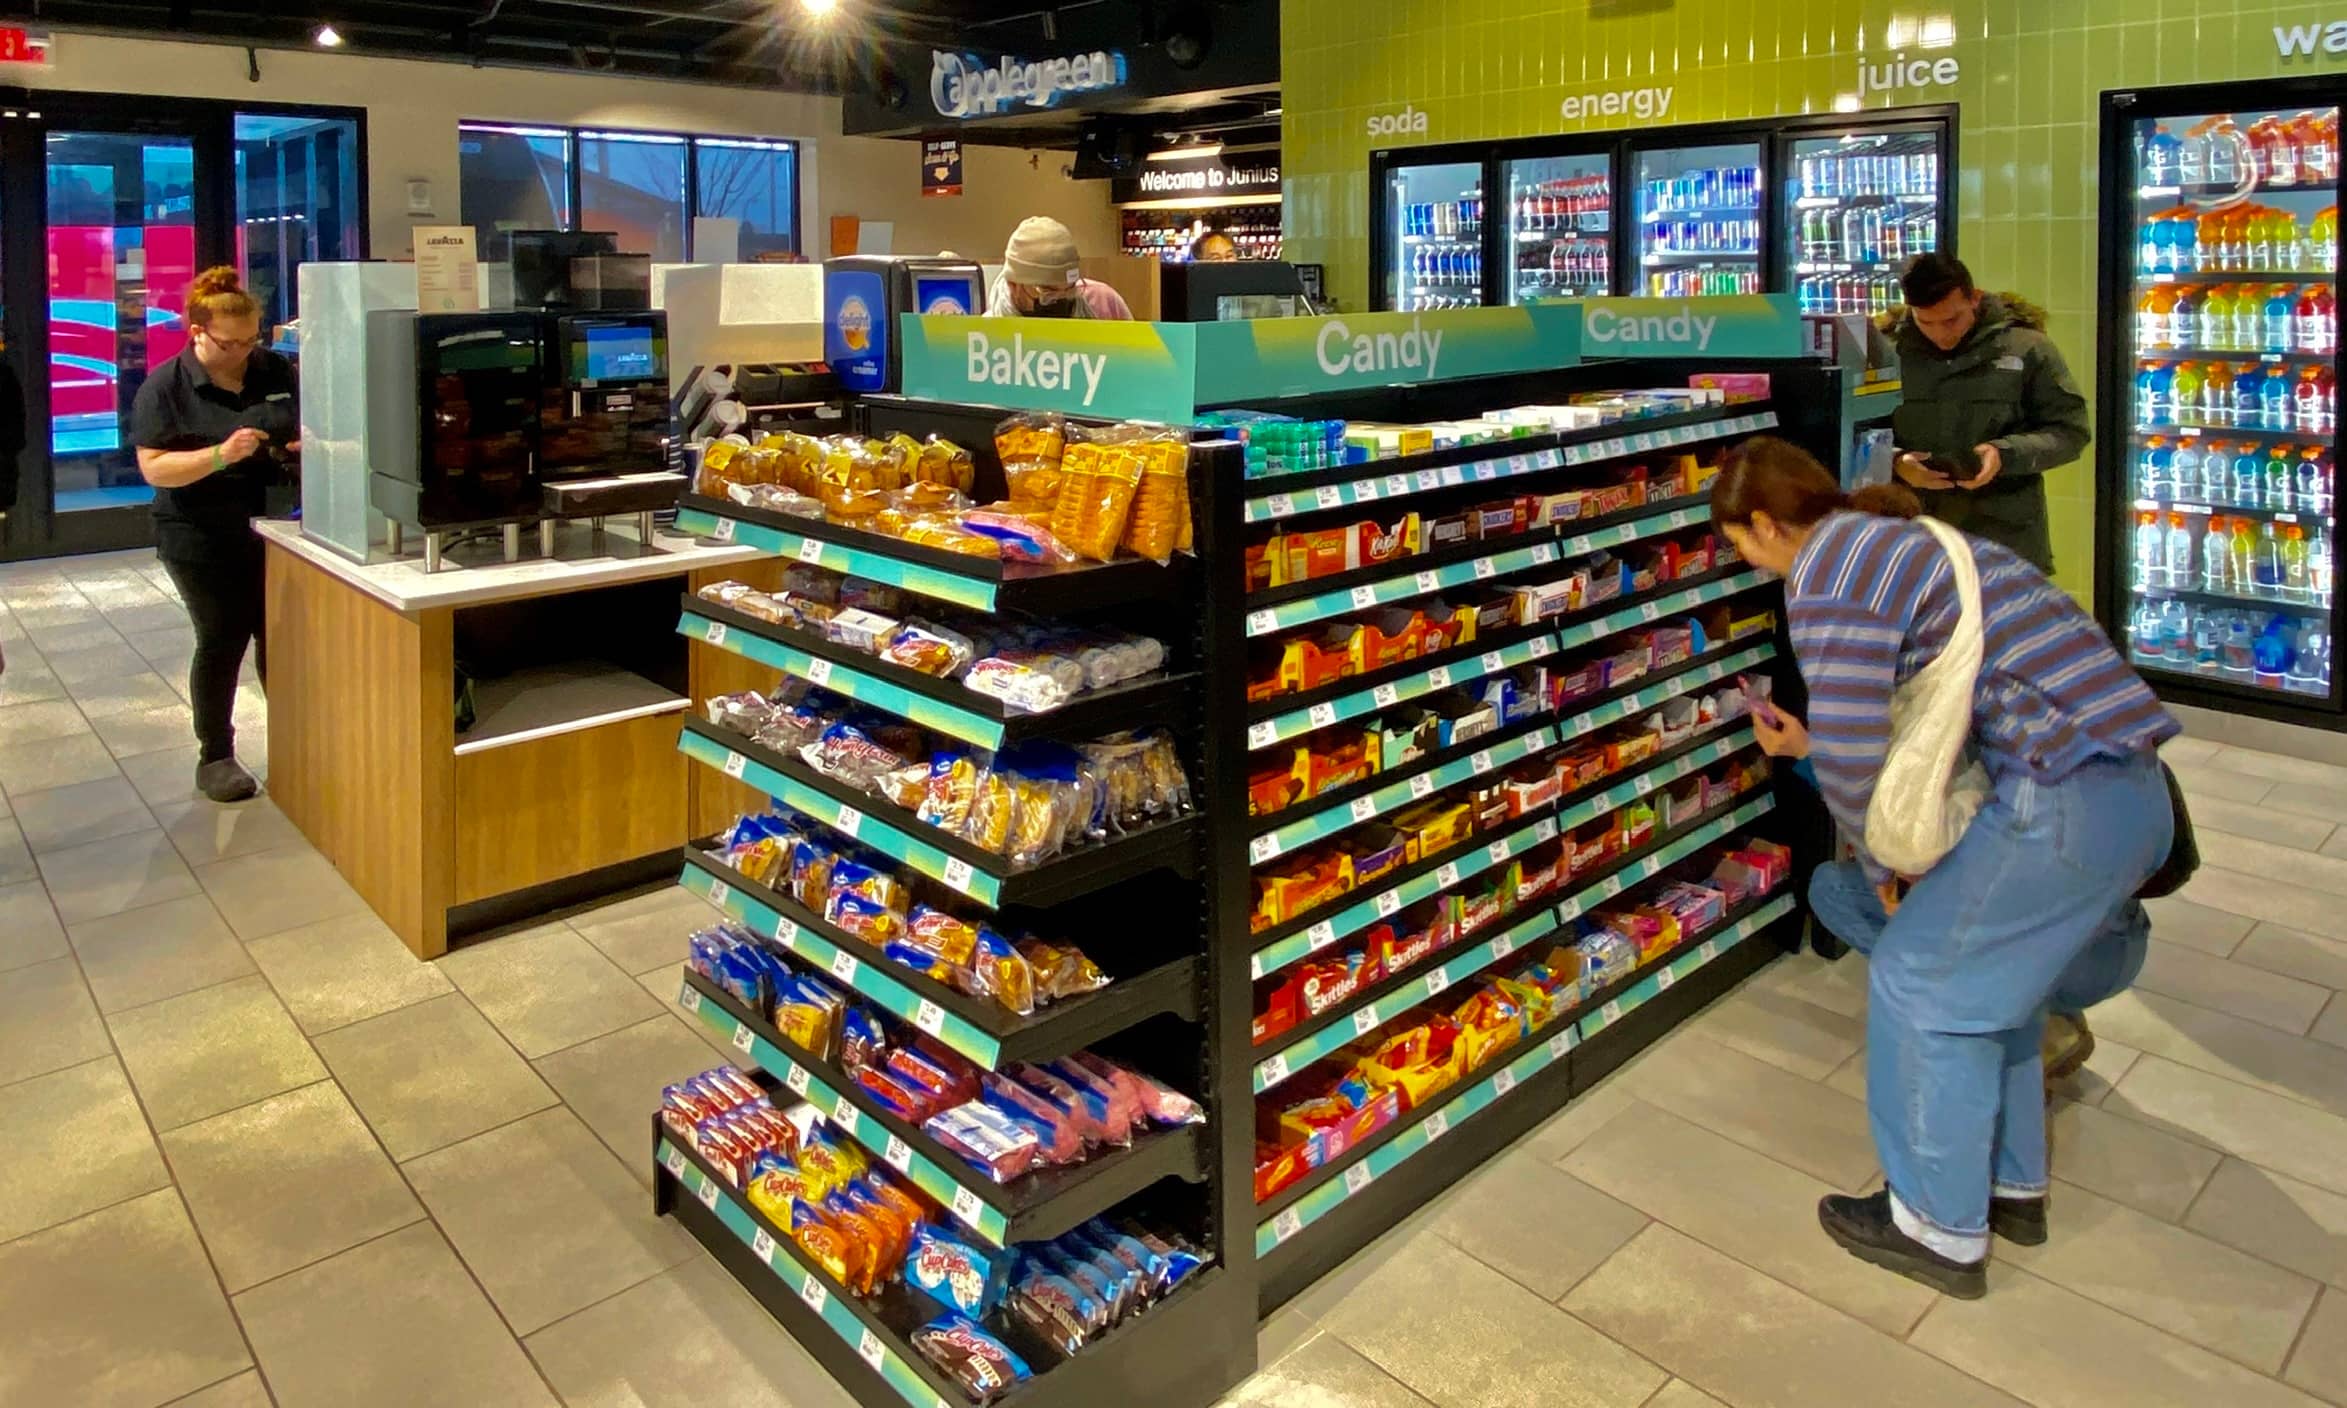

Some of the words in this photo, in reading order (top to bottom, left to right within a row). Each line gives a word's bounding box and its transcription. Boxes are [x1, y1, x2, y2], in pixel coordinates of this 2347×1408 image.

[1857, 53, 1958, 98] juice
[1367, 105, 1428, 137] soda
[1562, 85, 1673, 122] energy
[1140, 170, 1206, 191] Welcome
[1207, 167, 1224, 187] to
[1226, 164, 1279, 185] Junius
[1587, 303, 1717, 350] Candy
[967, 331, 1107, 406] Bakery
[1316, 317, 1443, 379] Candy
[1387, 940, 1431, 973] Skittles
[1311, 974, 1358, 1015] Skittles
